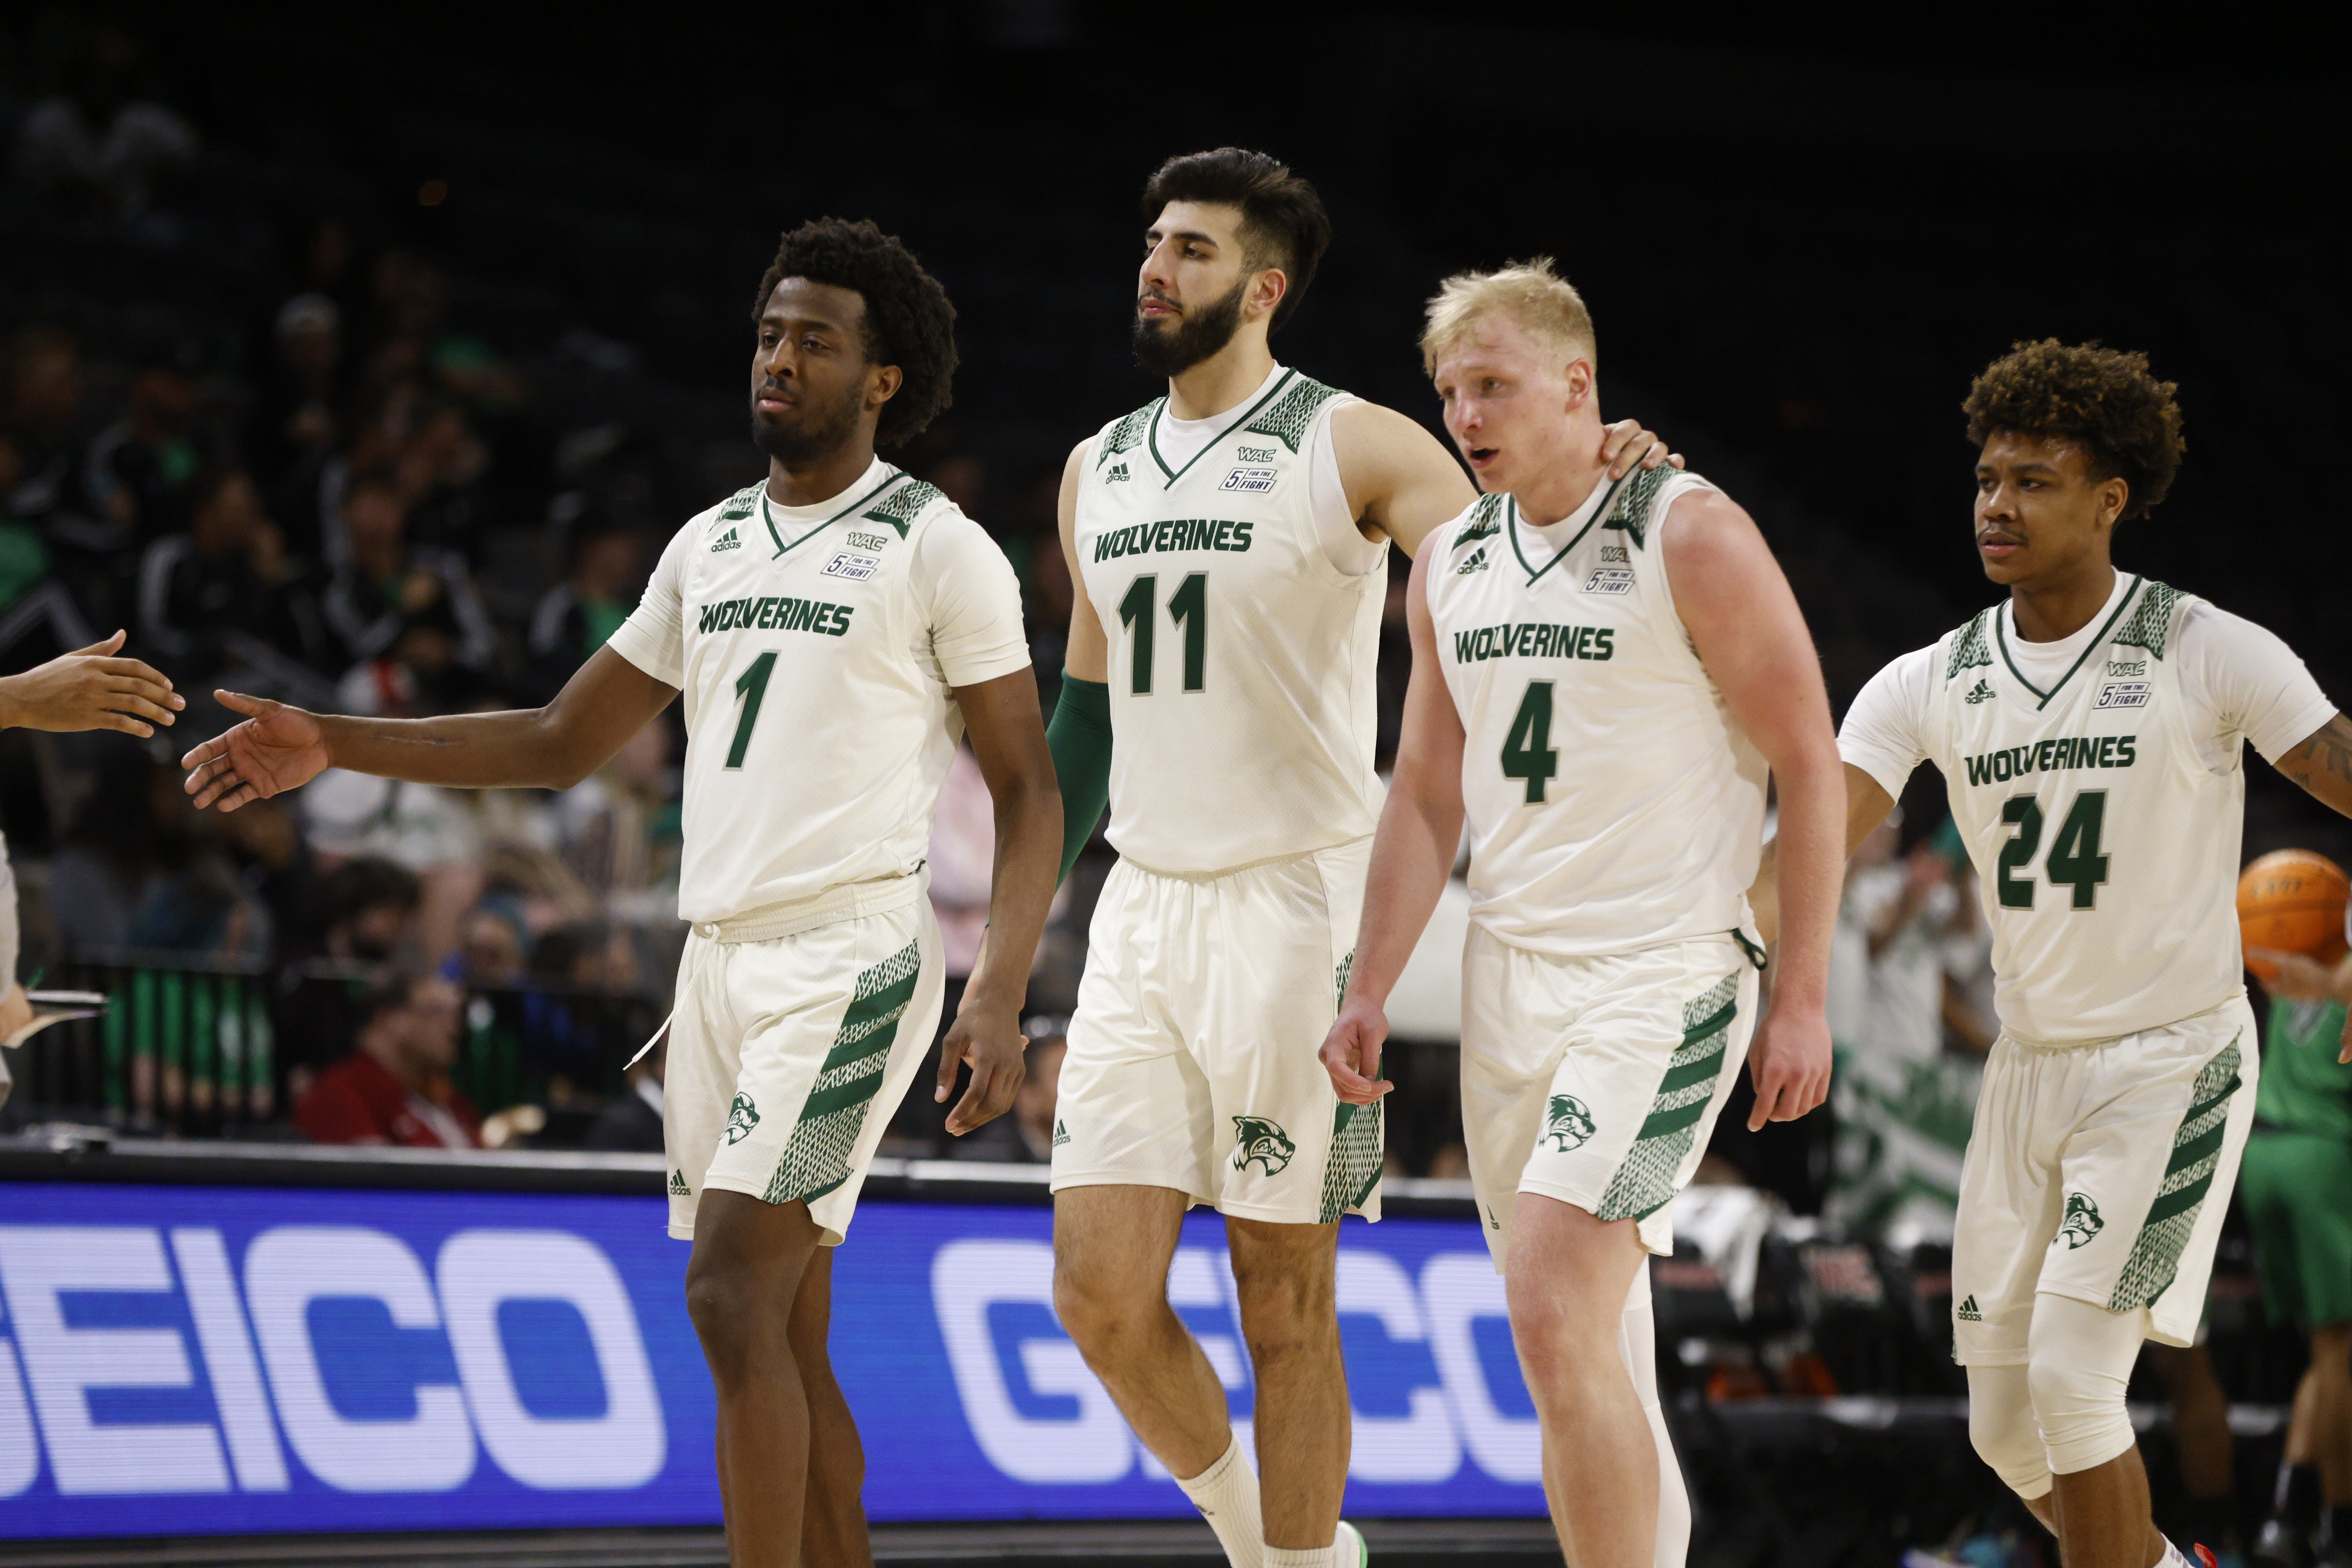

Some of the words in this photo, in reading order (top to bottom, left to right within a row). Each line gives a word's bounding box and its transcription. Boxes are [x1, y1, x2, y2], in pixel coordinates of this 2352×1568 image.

[1237, 447, 1276, 462] WAC
[1225, 470, 1244, 488] 5
[1240, 480, 1271, 489] FIGHT
[711, 541, 741, 553] adidas
[847, 532, 888, 552] WAC
[1094, 519, 1254, 563] WOLVERINES
[827, 554, 848, 572] 5
[1601, 546, 1631, 563] WA
[840, 567, 871, 578] FIGHT
[1585, 571, 1605, 591] 5
[1599, 582, 1629, 591] FIGHT
[699, 597, 854, 636] WOLVERINES
[1116, 571, 1209, 697] 11
[1454, 623, 1615, 664] WOLVERINES
[2107, 661, 2146, 676] WAC
[2099, 686, 2116, 706] 5
[2114, 695, 2145, 705] FIGHT
[721, 648, 782, 772] 1
[1500, 678, 1561, 807] 4
[1965, 736, 2136, 787] WOLVERINES
[1997, 788, 2112, 911] 24
[0, 1223, 669, 1498] EICO
